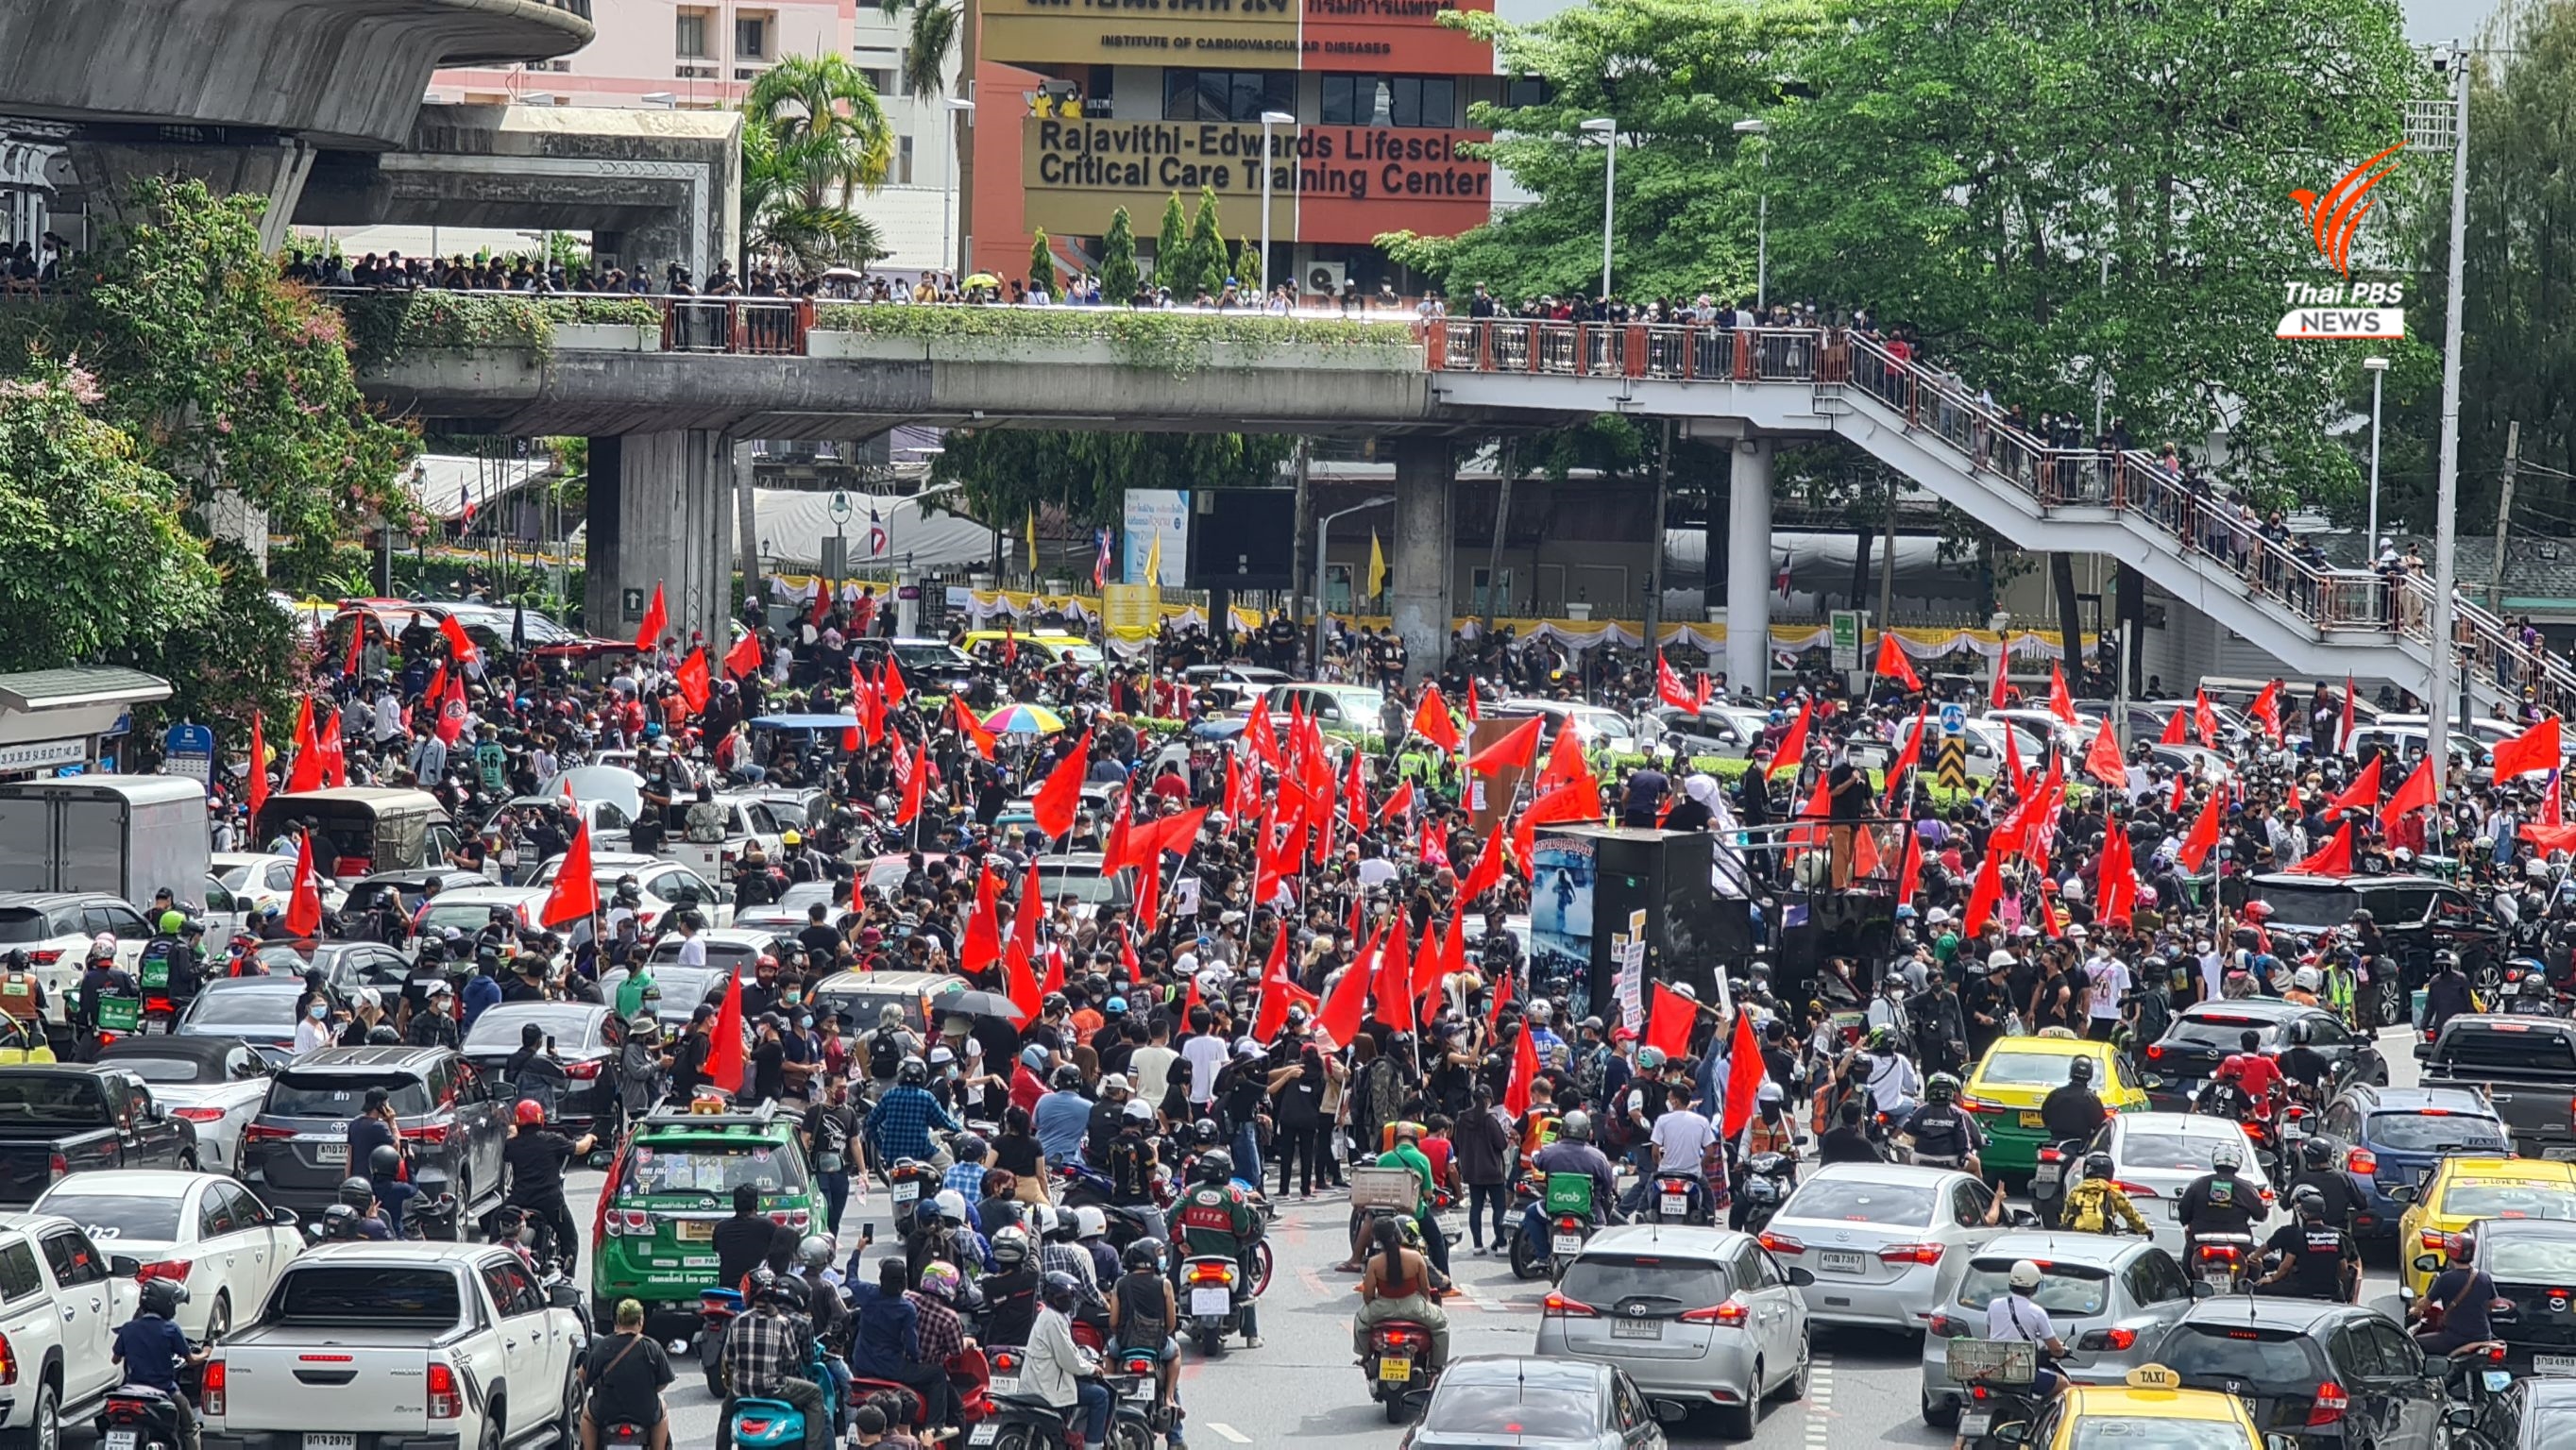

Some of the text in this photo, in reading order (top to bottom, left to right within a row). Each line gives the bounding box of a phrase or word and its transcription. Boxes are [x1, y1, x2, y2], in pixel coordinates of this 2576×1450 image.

[1101, 34, 1168, 48] INSTITUTE
[1173, 37, 1192, 49] OF
[1324, 42, 1391, 55] DISEASES
[1040, 120, 1333, 160] Rajavithi-Edwards
[1040, 152, 1150, 186] Critical
[1159, 156, 1229, 189] Care
[1381, 162, 1488, 195] Center
[481, 752, 498, 768] 56
[2049, 1029, 2064, 1037] TAXI
[2468, 1137, 2499, 1146] TAXI
[1553, 1191, 1581, 1203] Grab
[2140, 1371, 2165, 1383] TAXI
[329, 1435, 353, 1446] 2975
